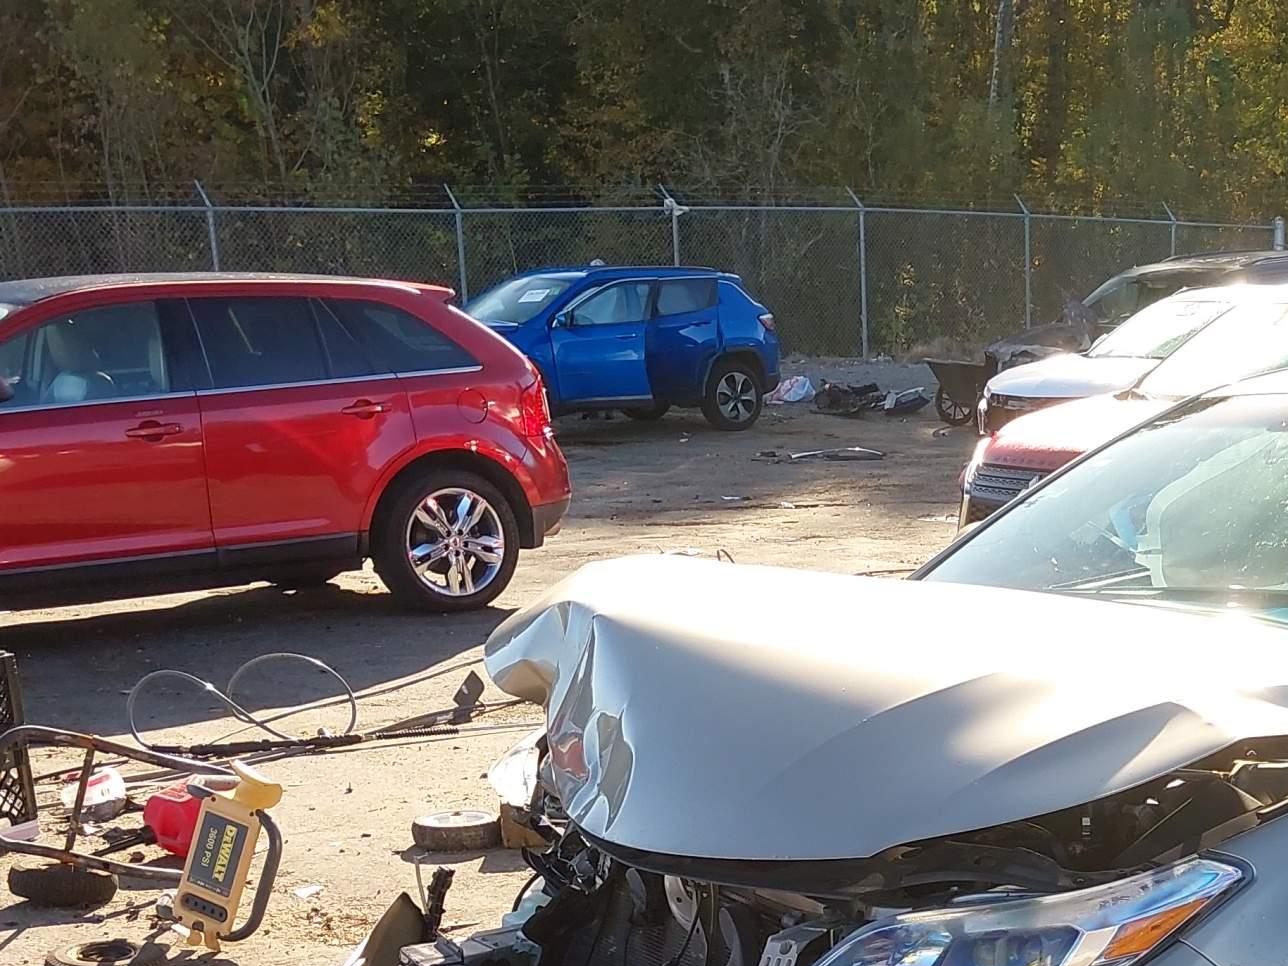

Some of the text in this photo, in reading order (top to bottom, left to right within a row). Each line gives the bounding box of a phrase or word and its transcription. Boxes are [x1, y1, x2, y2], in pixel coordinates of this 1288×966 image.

[201, 827, 218, 868] 3600 PSI
[212, 824, 238, 882] DEWALT
